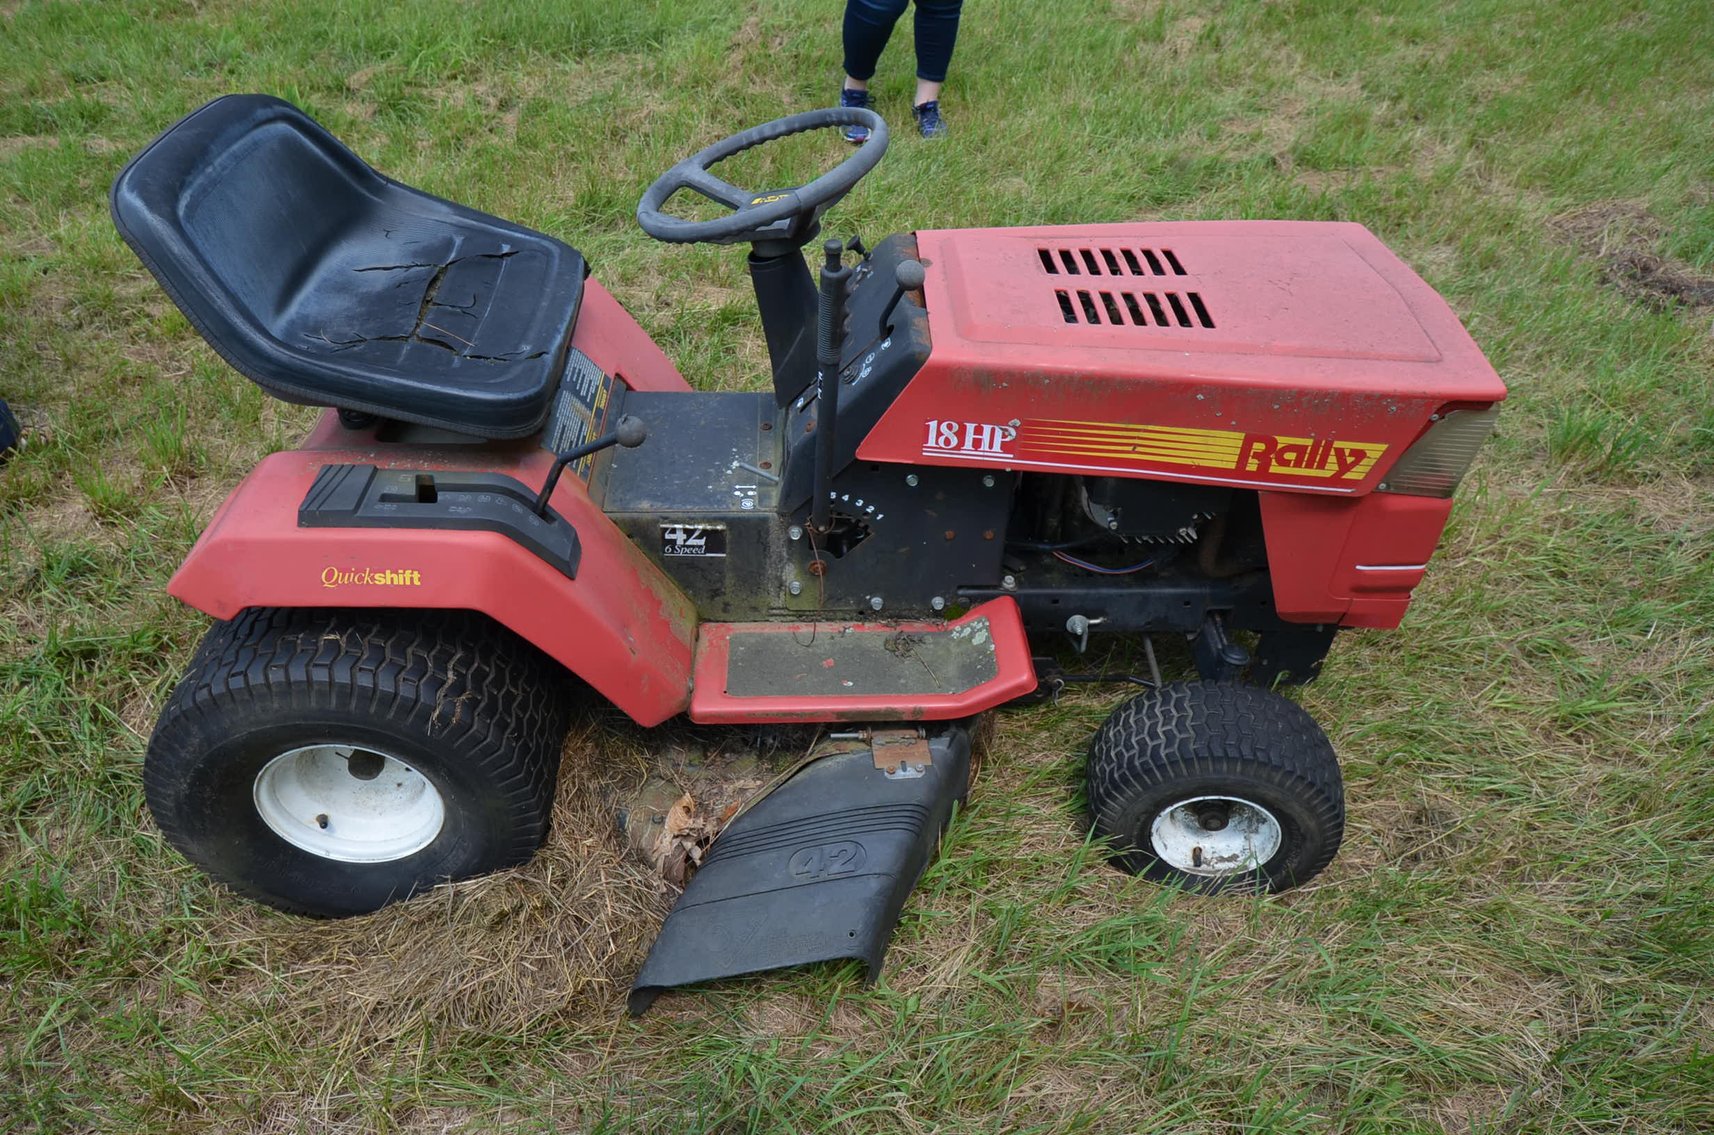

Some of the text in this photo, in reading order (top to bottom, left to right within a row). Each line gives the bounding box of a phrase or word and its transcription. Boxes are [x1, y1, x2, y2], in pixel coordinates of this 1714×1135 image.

[923, 420, 1017, 454] 18 HP
[1234, 432, 1368, 480] Rally
[830, 491, 885, 521] 5 4 3 2 1
[664, 545, 706, 557] 6 Speed
[321, 566, 422, 588] Quickshift
[794, 844, 857, 879] 42
